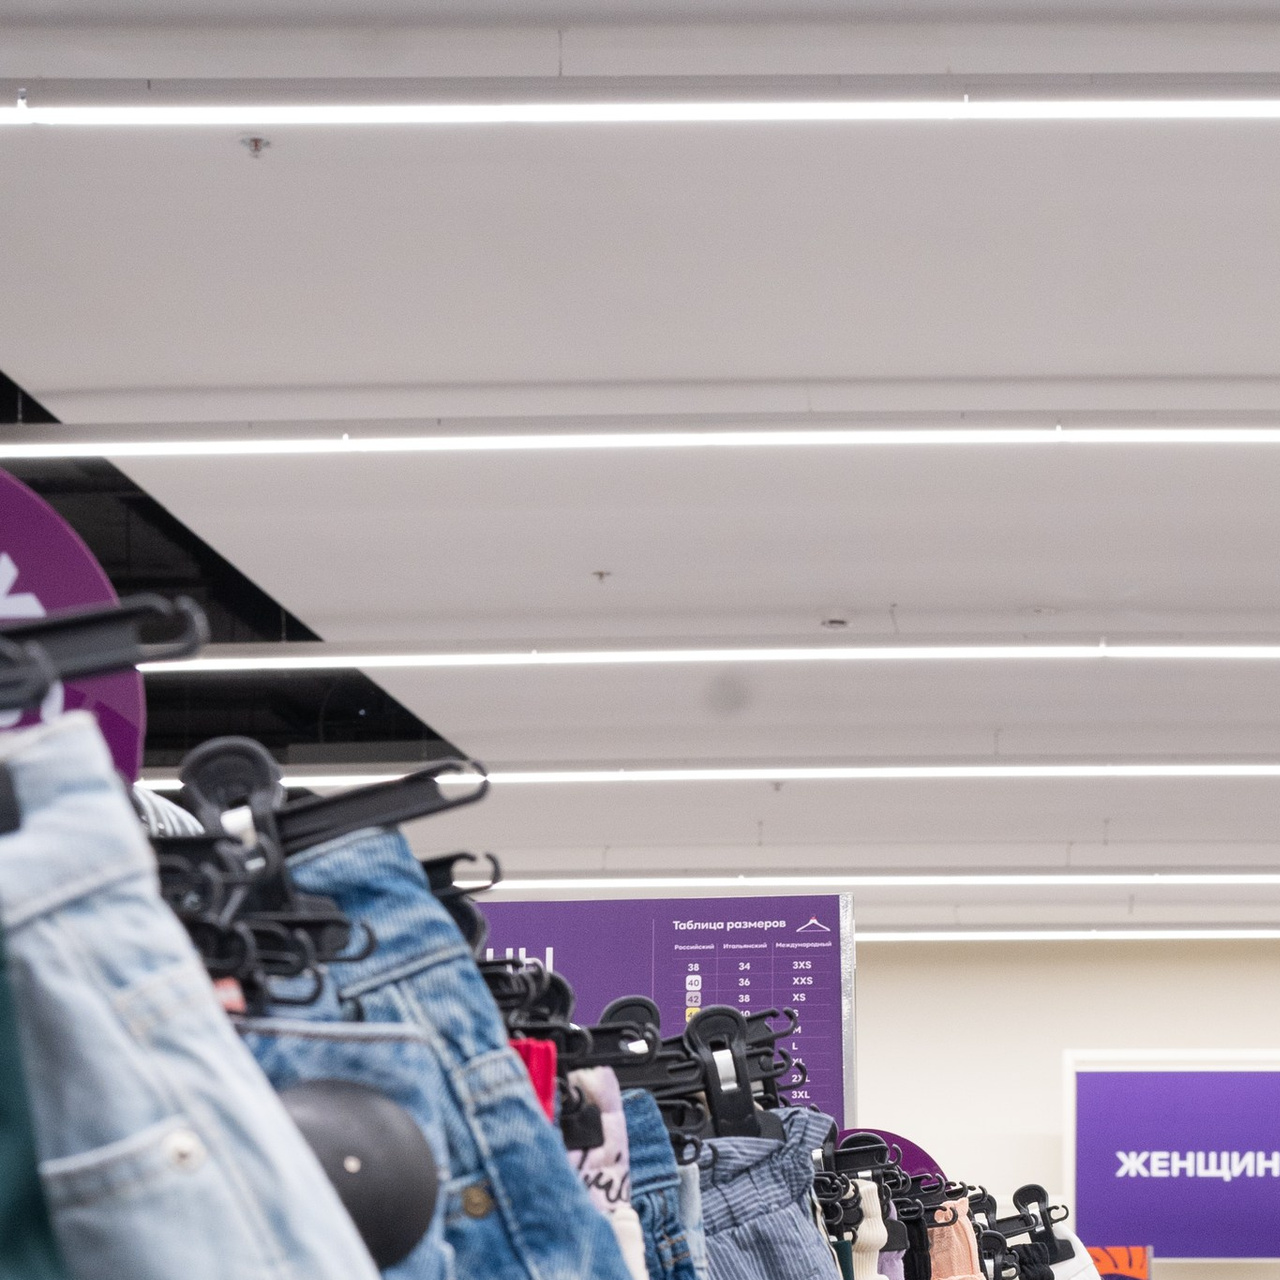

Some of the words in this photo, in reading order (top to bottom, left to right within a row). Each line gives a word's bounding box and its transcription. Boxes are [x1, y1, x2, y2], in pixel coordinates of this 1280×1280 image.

[672, 921, 724, 930] Таблица
[726, 920, 786, 931] размеров
[687, 963, 700, 972] 38
[738, 962, 750, 971] 34
[792, 961, 812, 970] 3XS
[688, 979, 700, 987] 40
[738, 978, 750, 987] 36
[792, 976, 813, 986] XXS
[687, 995, 700, 1004] 42
[738, 994, 750, 1003] 38
[792, 993, 806, 1002] XS
[792, 1042, 798, 1050] L
[791, 1090, 811, 1099] 3XL
